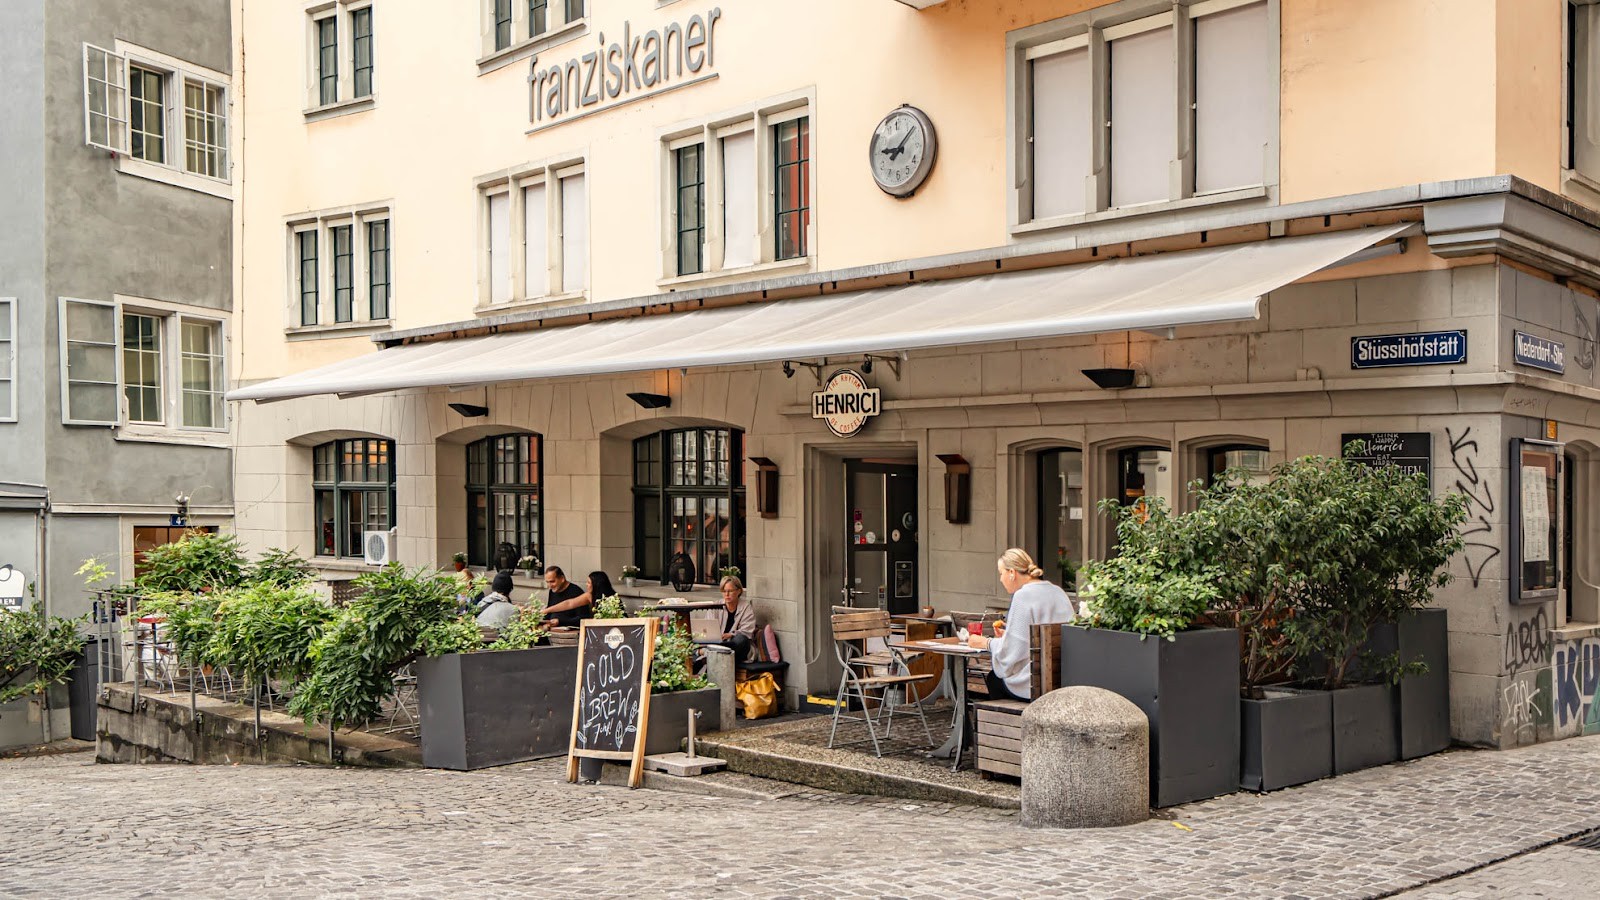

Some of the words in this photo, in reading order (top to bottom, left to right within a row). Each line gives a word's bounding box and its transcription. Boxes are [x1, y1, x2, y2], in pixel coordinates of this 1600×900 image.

[527, 7, 720, 124] franziskaner
[815, 392, 876, 415] HENRICI
[839, 415, 861, 432] COFFEE
[1363, 439, 1404, 456] Henrici
[586, 645, 635, 694] COLD
[588, 687, 632, 722] BREW
